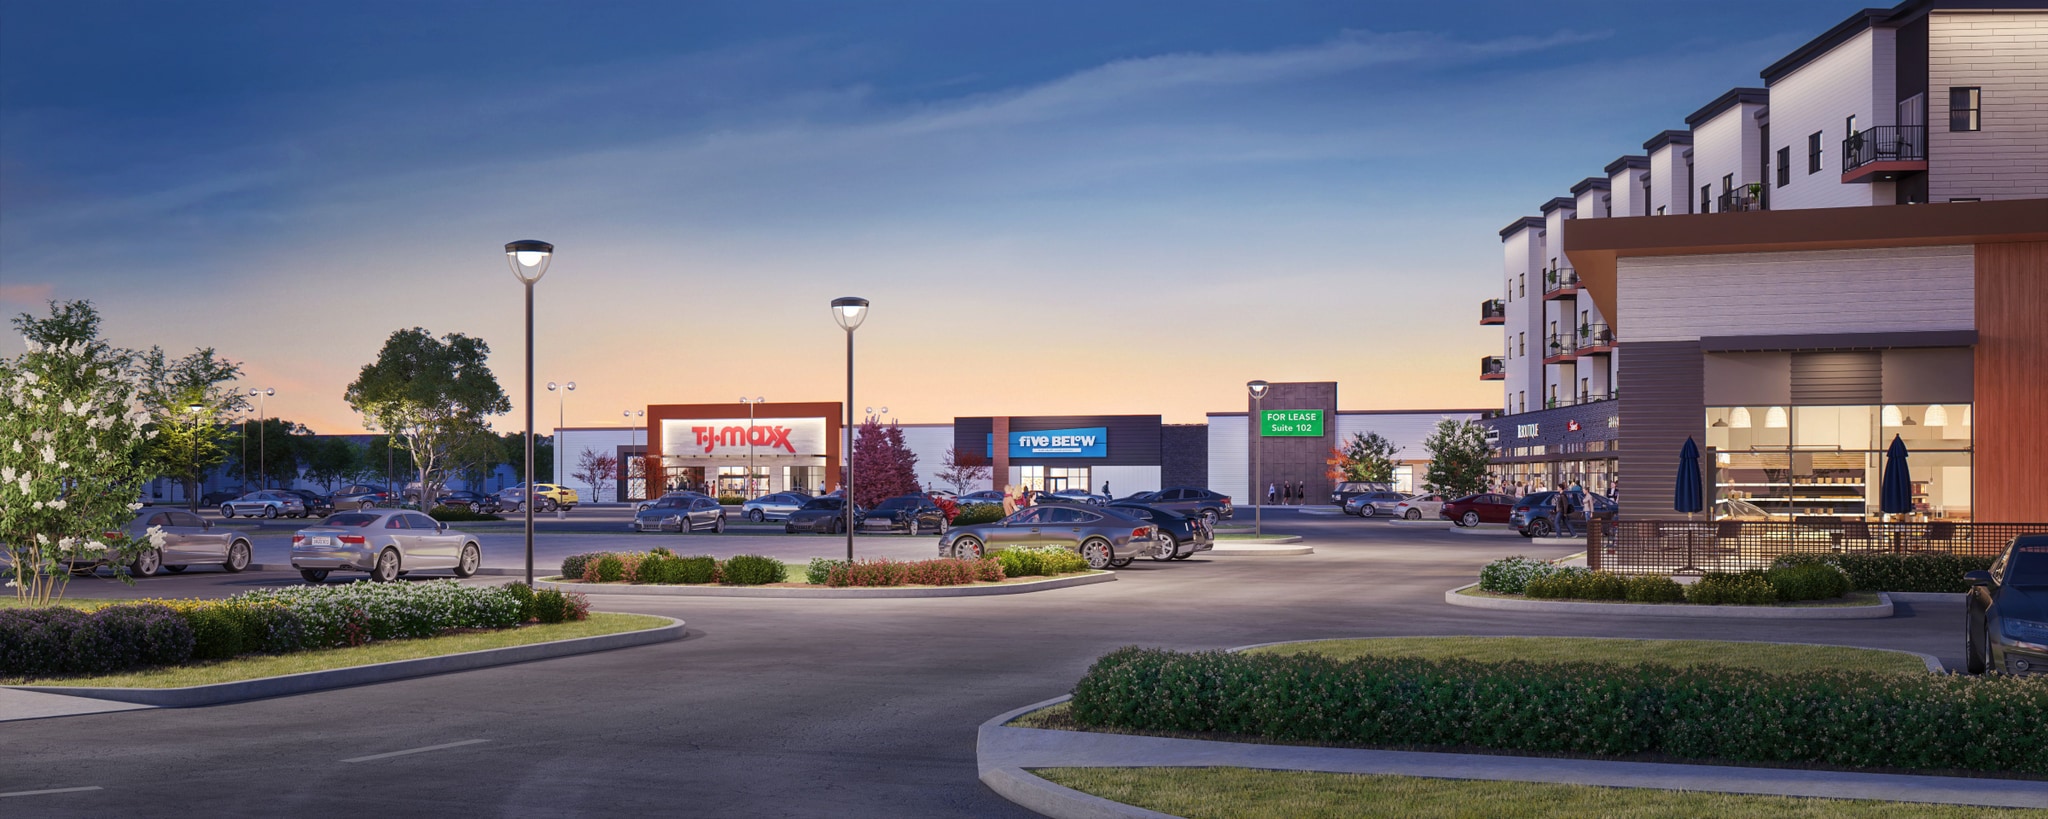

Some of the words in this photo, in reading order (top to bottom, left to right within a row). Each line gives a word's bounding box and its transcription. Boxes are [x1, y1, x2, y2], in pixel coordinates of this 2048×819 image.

[1267, 413, 1286, 421] FOR
[1288, 413, 1317, 421] LEASE
[1271, 424, 1293, 432] Suite
[1296, 424, 1312, 432] 102
[1019, 435, 1050, 447] five
